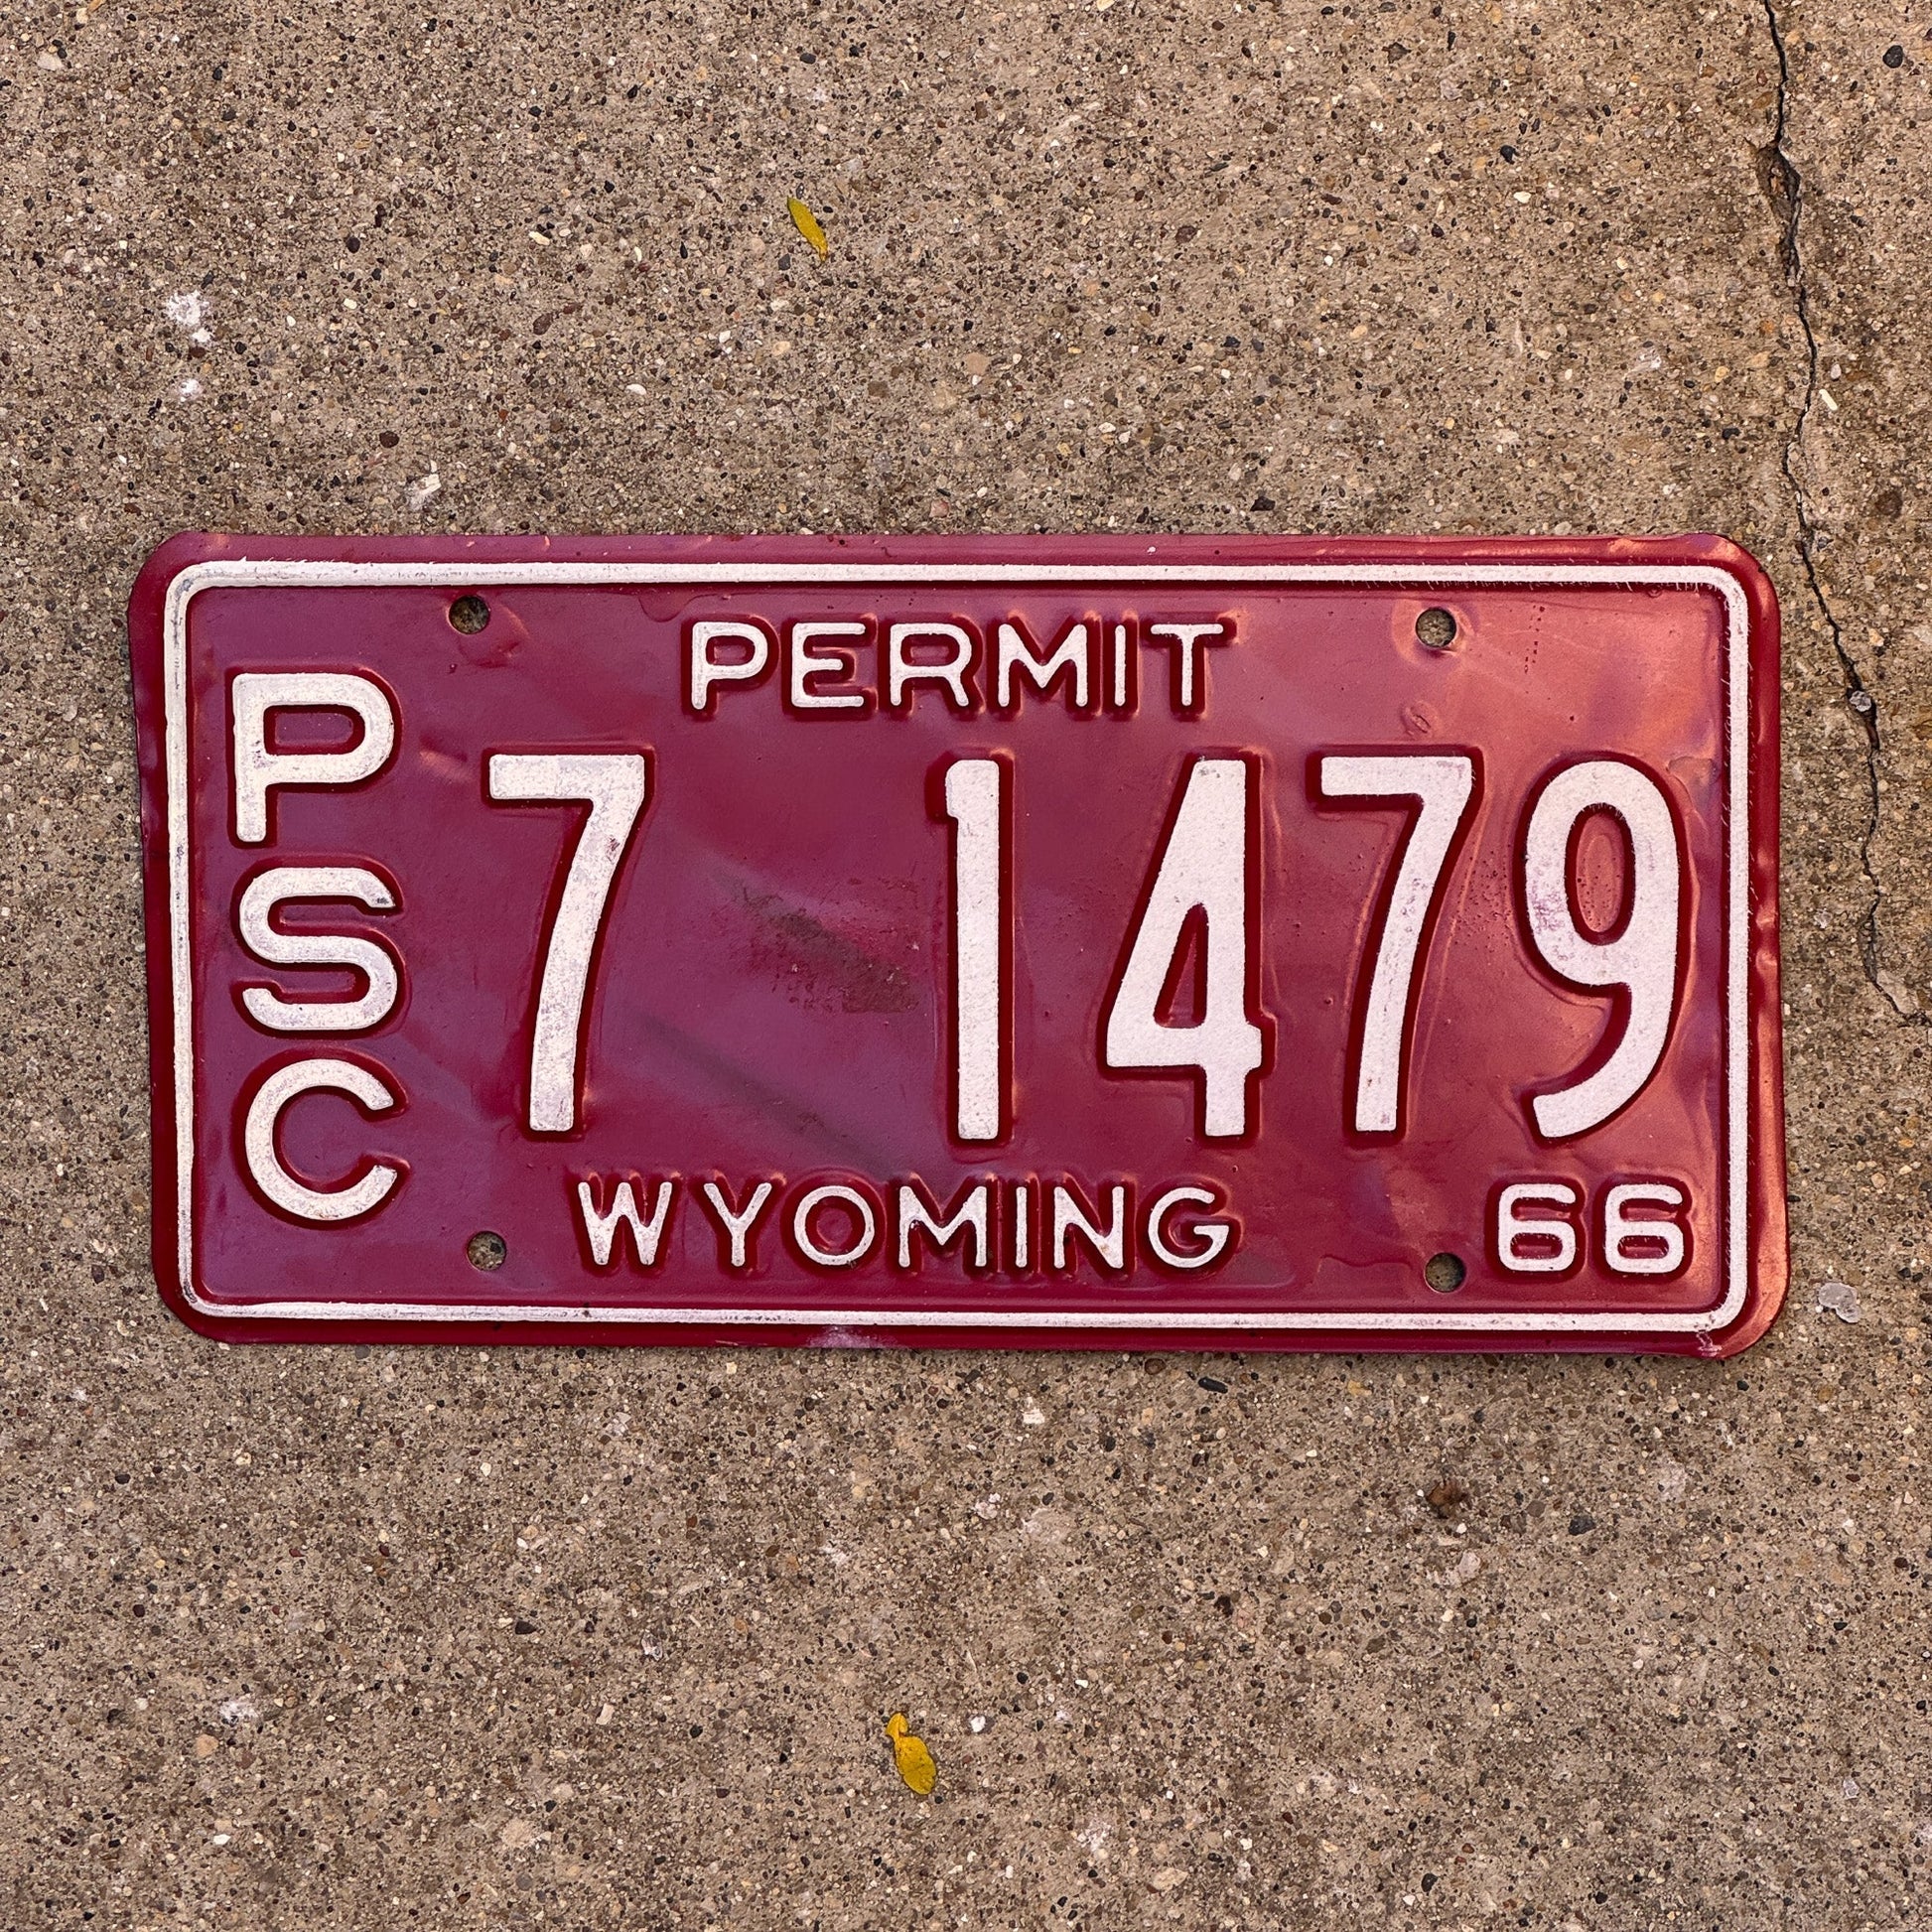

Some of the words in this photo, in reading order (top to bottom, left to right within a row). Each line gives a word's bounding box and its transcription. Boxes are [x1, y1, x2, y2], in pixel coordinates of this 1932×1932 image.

[690, 620, 1225, 711] PERMIT
[231, 672, 399, 1222] PSC
[488, 754, 646, 1133] 7
[943, 757, 1681, 1141] 1479
[578, 1180, 1231, 1270] WYOMING
[1496, 1182, 1686, 1275] 66
